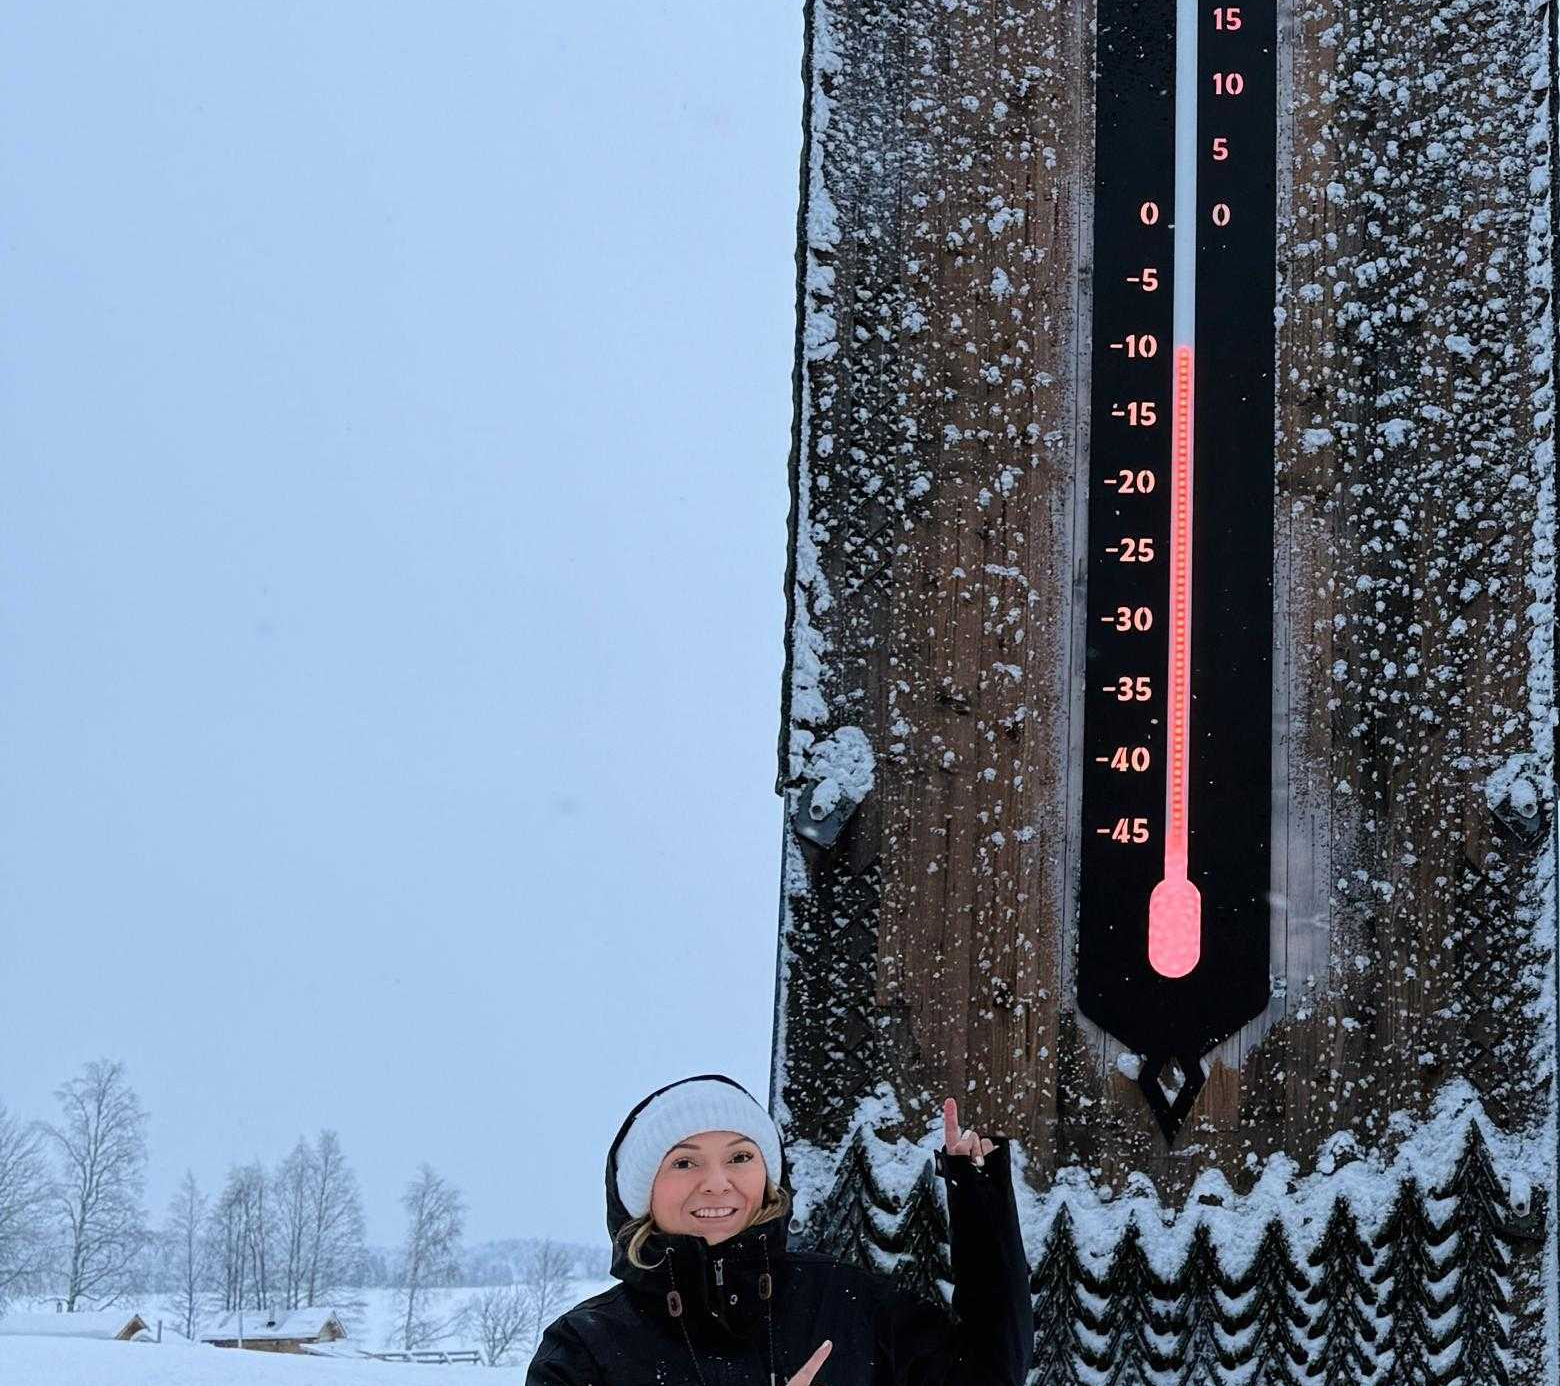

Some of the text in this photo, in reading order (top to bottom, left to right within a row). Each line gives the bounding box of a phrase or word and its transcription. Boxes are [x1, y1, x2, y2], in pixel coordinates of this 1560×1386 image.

[1214, 8, 1242, 30] 15
[1213, 73, 1243, 95] 10
[1212, 138, 1229, 160] 5
[1140, 202, 1159, 225] 0
[1212, 203, 1231, 227] 0
[1127, 269, 1159, 292] -5
[1110, 335, 1158, 358] -10
[1111, 403, 1157, 426] -15
[1104, 470, 1156, 494] -20
[1106, 538, 1155, 562] -25
[1101, 607, 1153, 631] -30
[1103, 677, 1152, 701] -35
[1096, 747, 1151, 772] -40
[1097, 818, 1149, 843] -45
